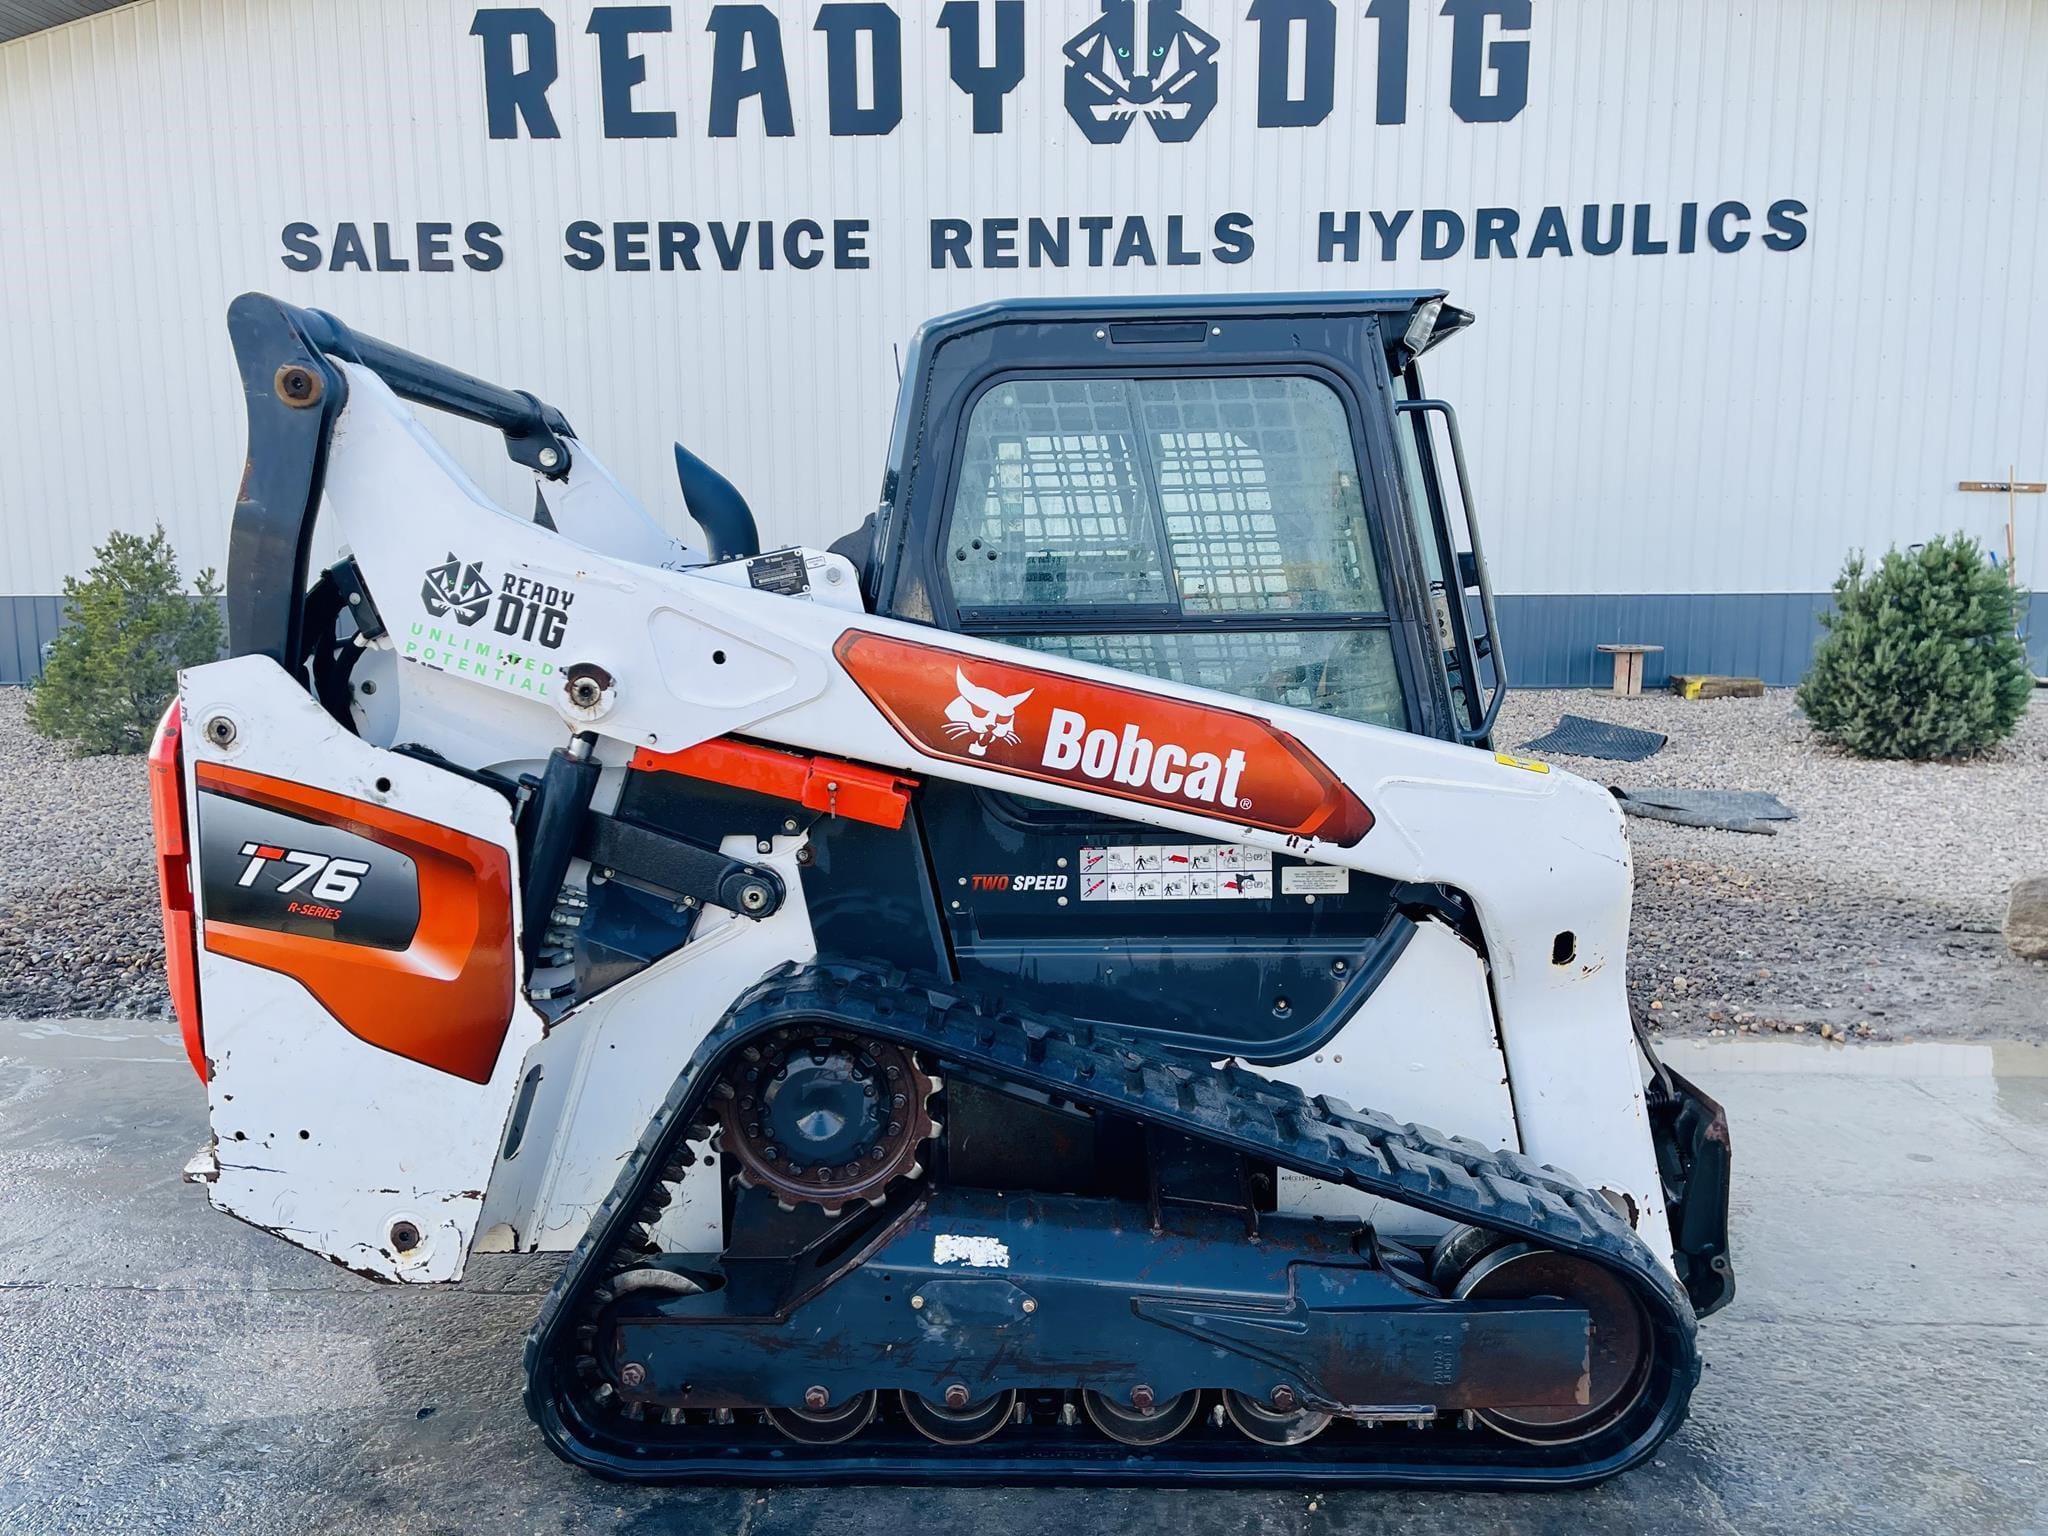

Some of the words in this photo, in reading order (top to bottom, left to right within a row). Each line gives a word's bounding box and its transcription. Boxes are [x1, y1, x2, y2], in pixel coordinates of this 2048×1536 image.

[469, 0, 1025, 139] READY
[1245, 0, 1532, 127] DIG
[280, 221, 504, 272] SALES
[564, 219, 870, 271] SERVICE
[930, 212, 1255, 269] RENTALS
[1317, 200, 1808, 262] HYDRAULICS
[501, 572, 575, 611] READY
[494, 592, 568, 650] DIG
[404, 641, 549, 696] POTENTIAL
[410, 622, 554, 677] UNLIMITED
[238, 842, 371, 903] T76
[971, 875, 1009, 891] TWO
[1012, 874, 1068, 891] SPEED
[288, 902, 342, 920] R-SERIES
